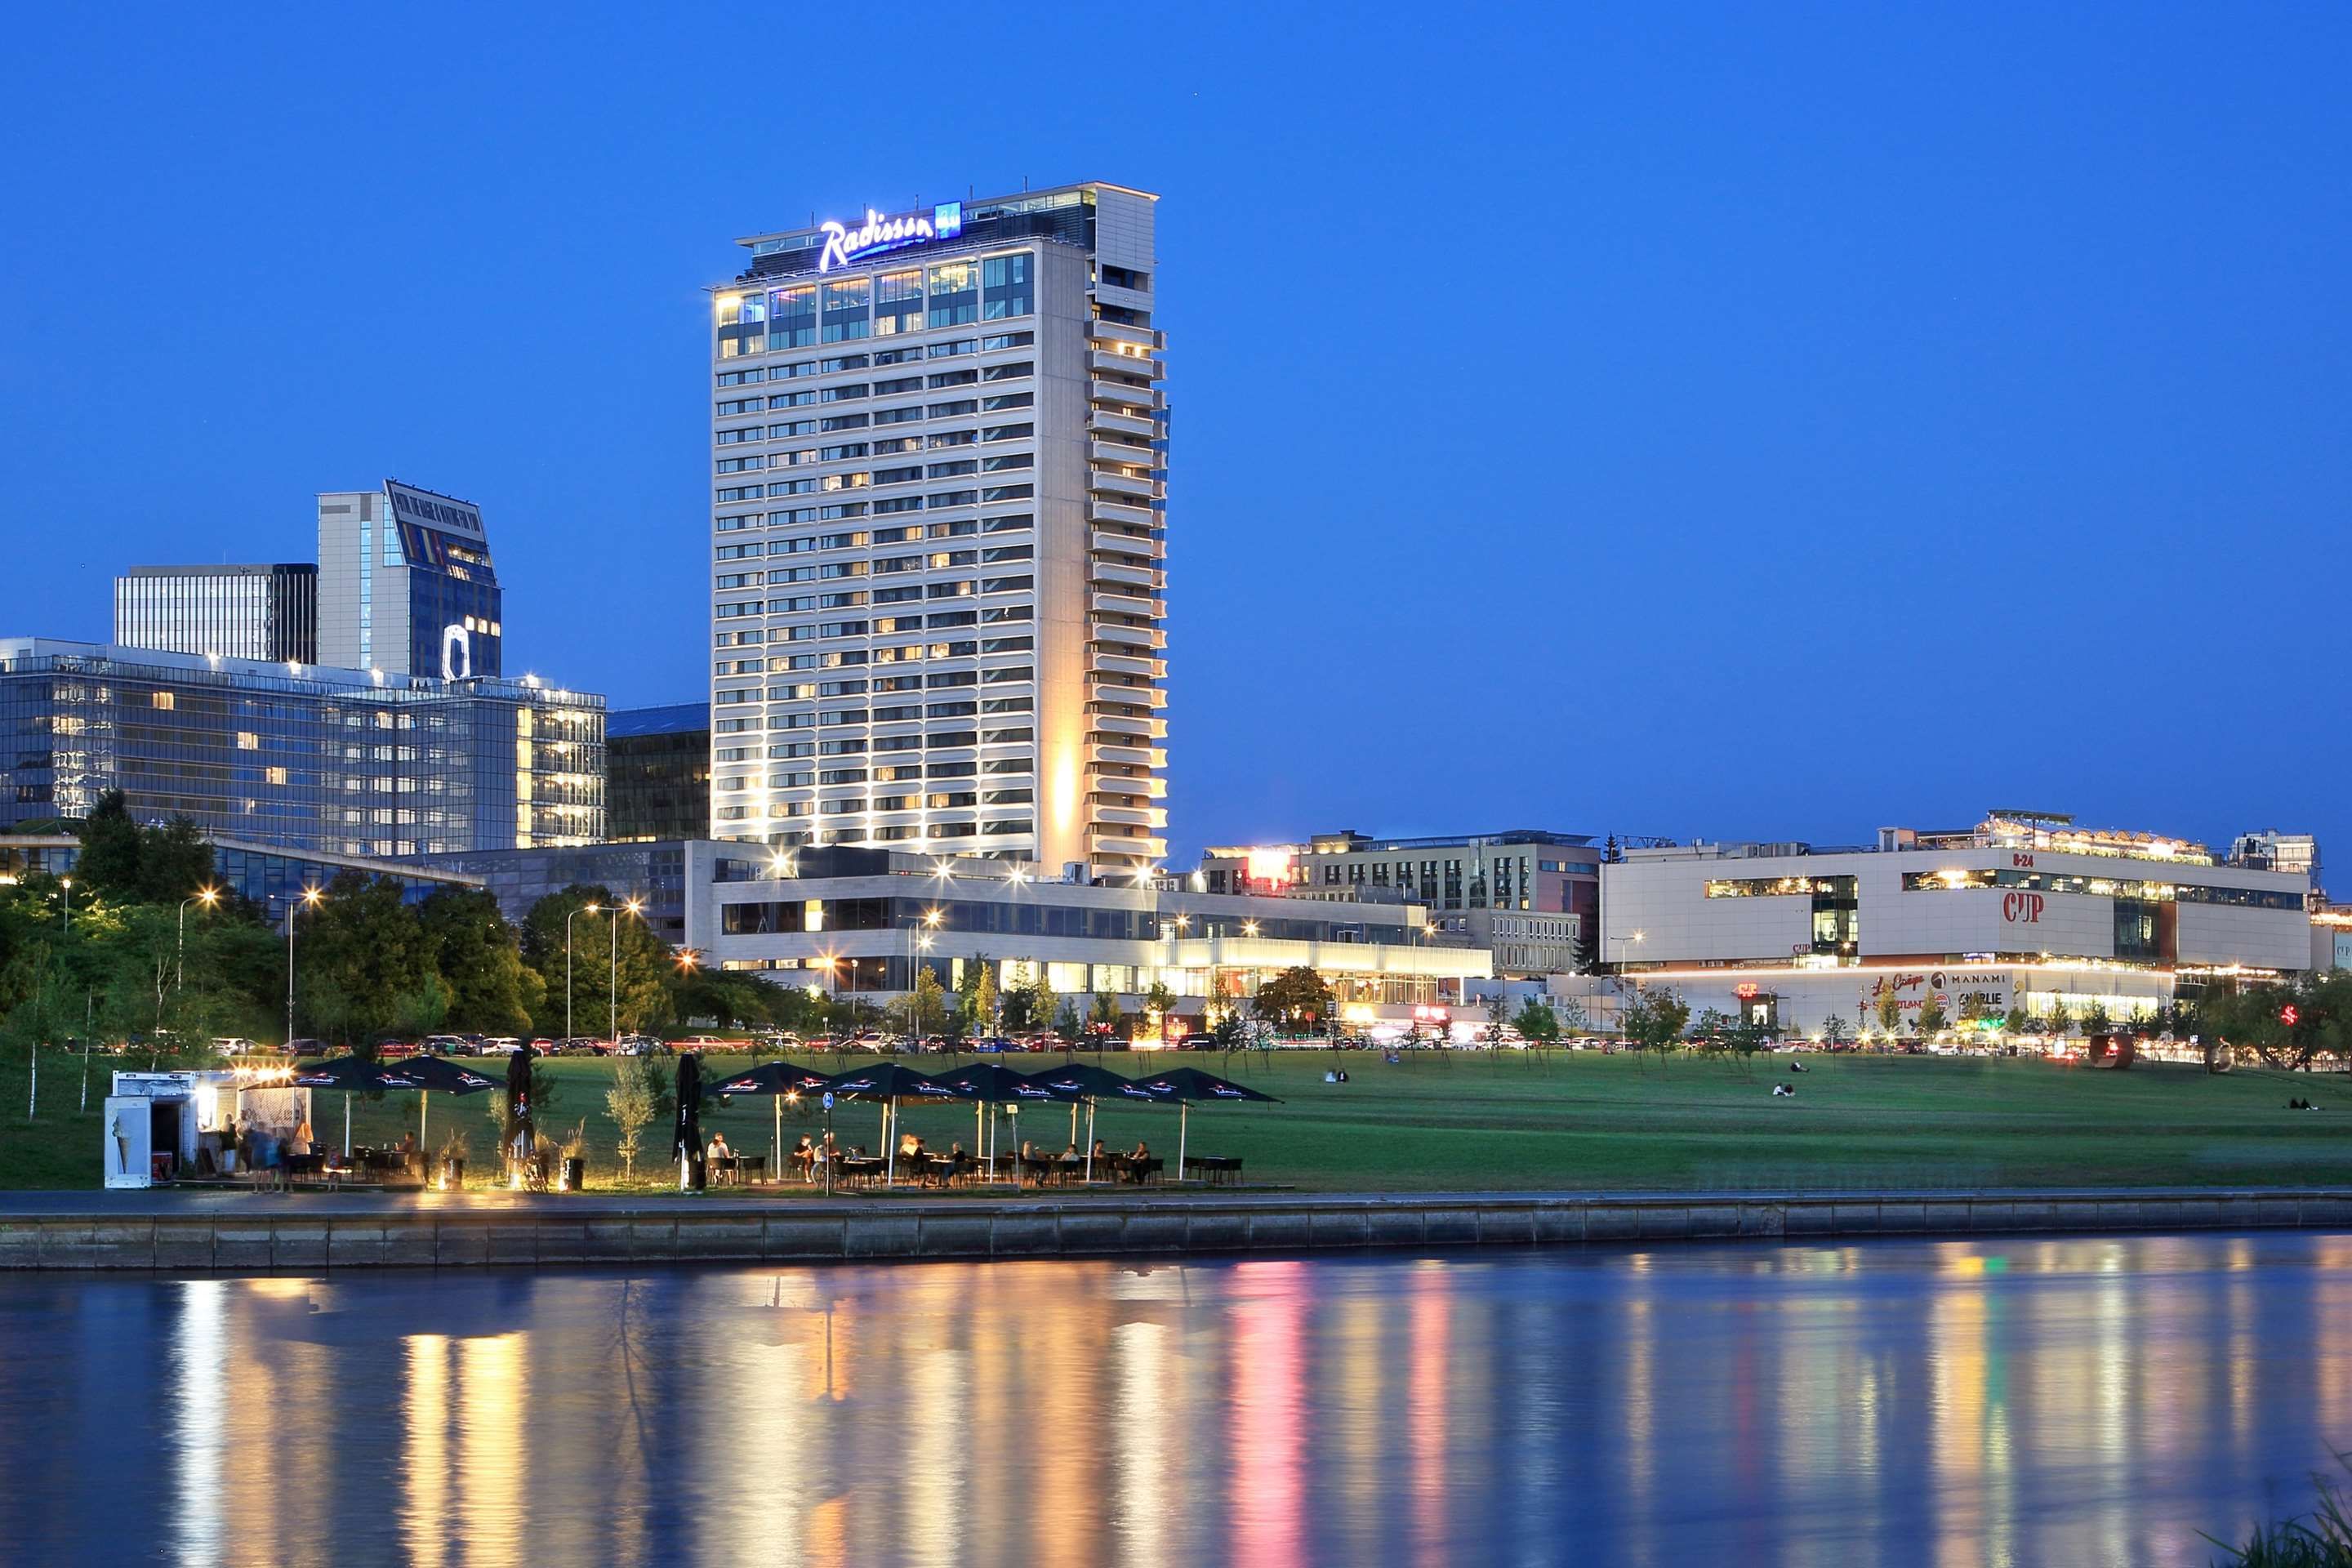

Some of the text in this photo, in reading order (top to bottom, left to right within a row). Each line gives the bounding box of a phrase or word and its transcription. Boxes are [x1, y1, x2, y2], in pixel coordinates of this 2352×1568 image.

[819, 208, 933, 274] Radisson
[2013, 853, 2034, 867] 8-24
[2003, 892, 2044, 923] CUP
[1793, 943, 1811, 954] CUP
[1952, 974, 2005, 984] MANAMI
[1960, 992, 2002, 1005] CHRLIE
